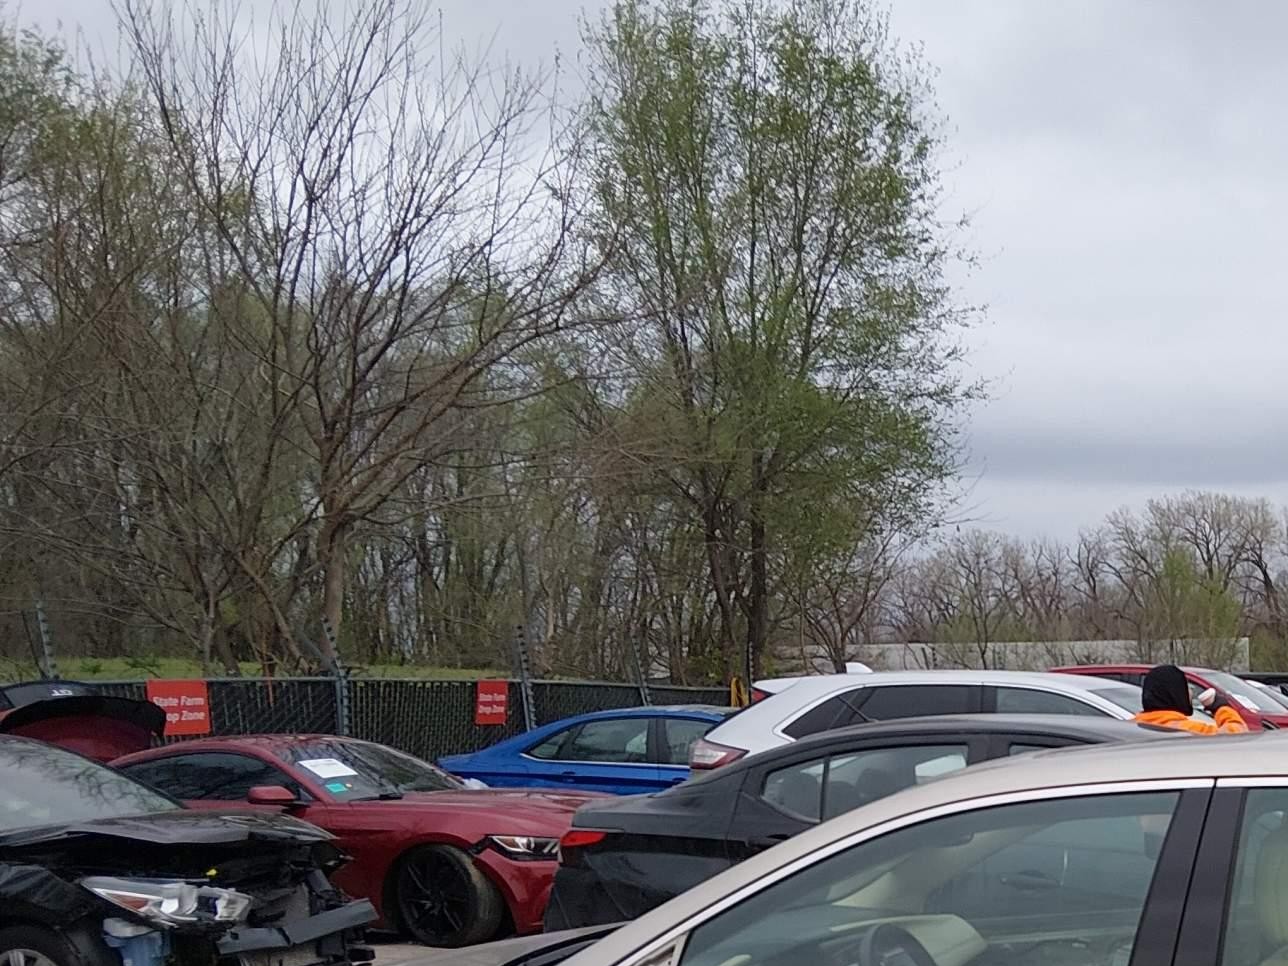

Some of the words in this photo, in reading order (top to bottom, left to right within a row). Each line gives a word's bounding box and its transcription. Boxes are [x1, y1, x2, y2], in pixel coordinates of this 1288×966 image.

[152, 696, 178, 707] State
[180, 695, 205, 706] Farm
[181, 710, 205, 721] Zone
